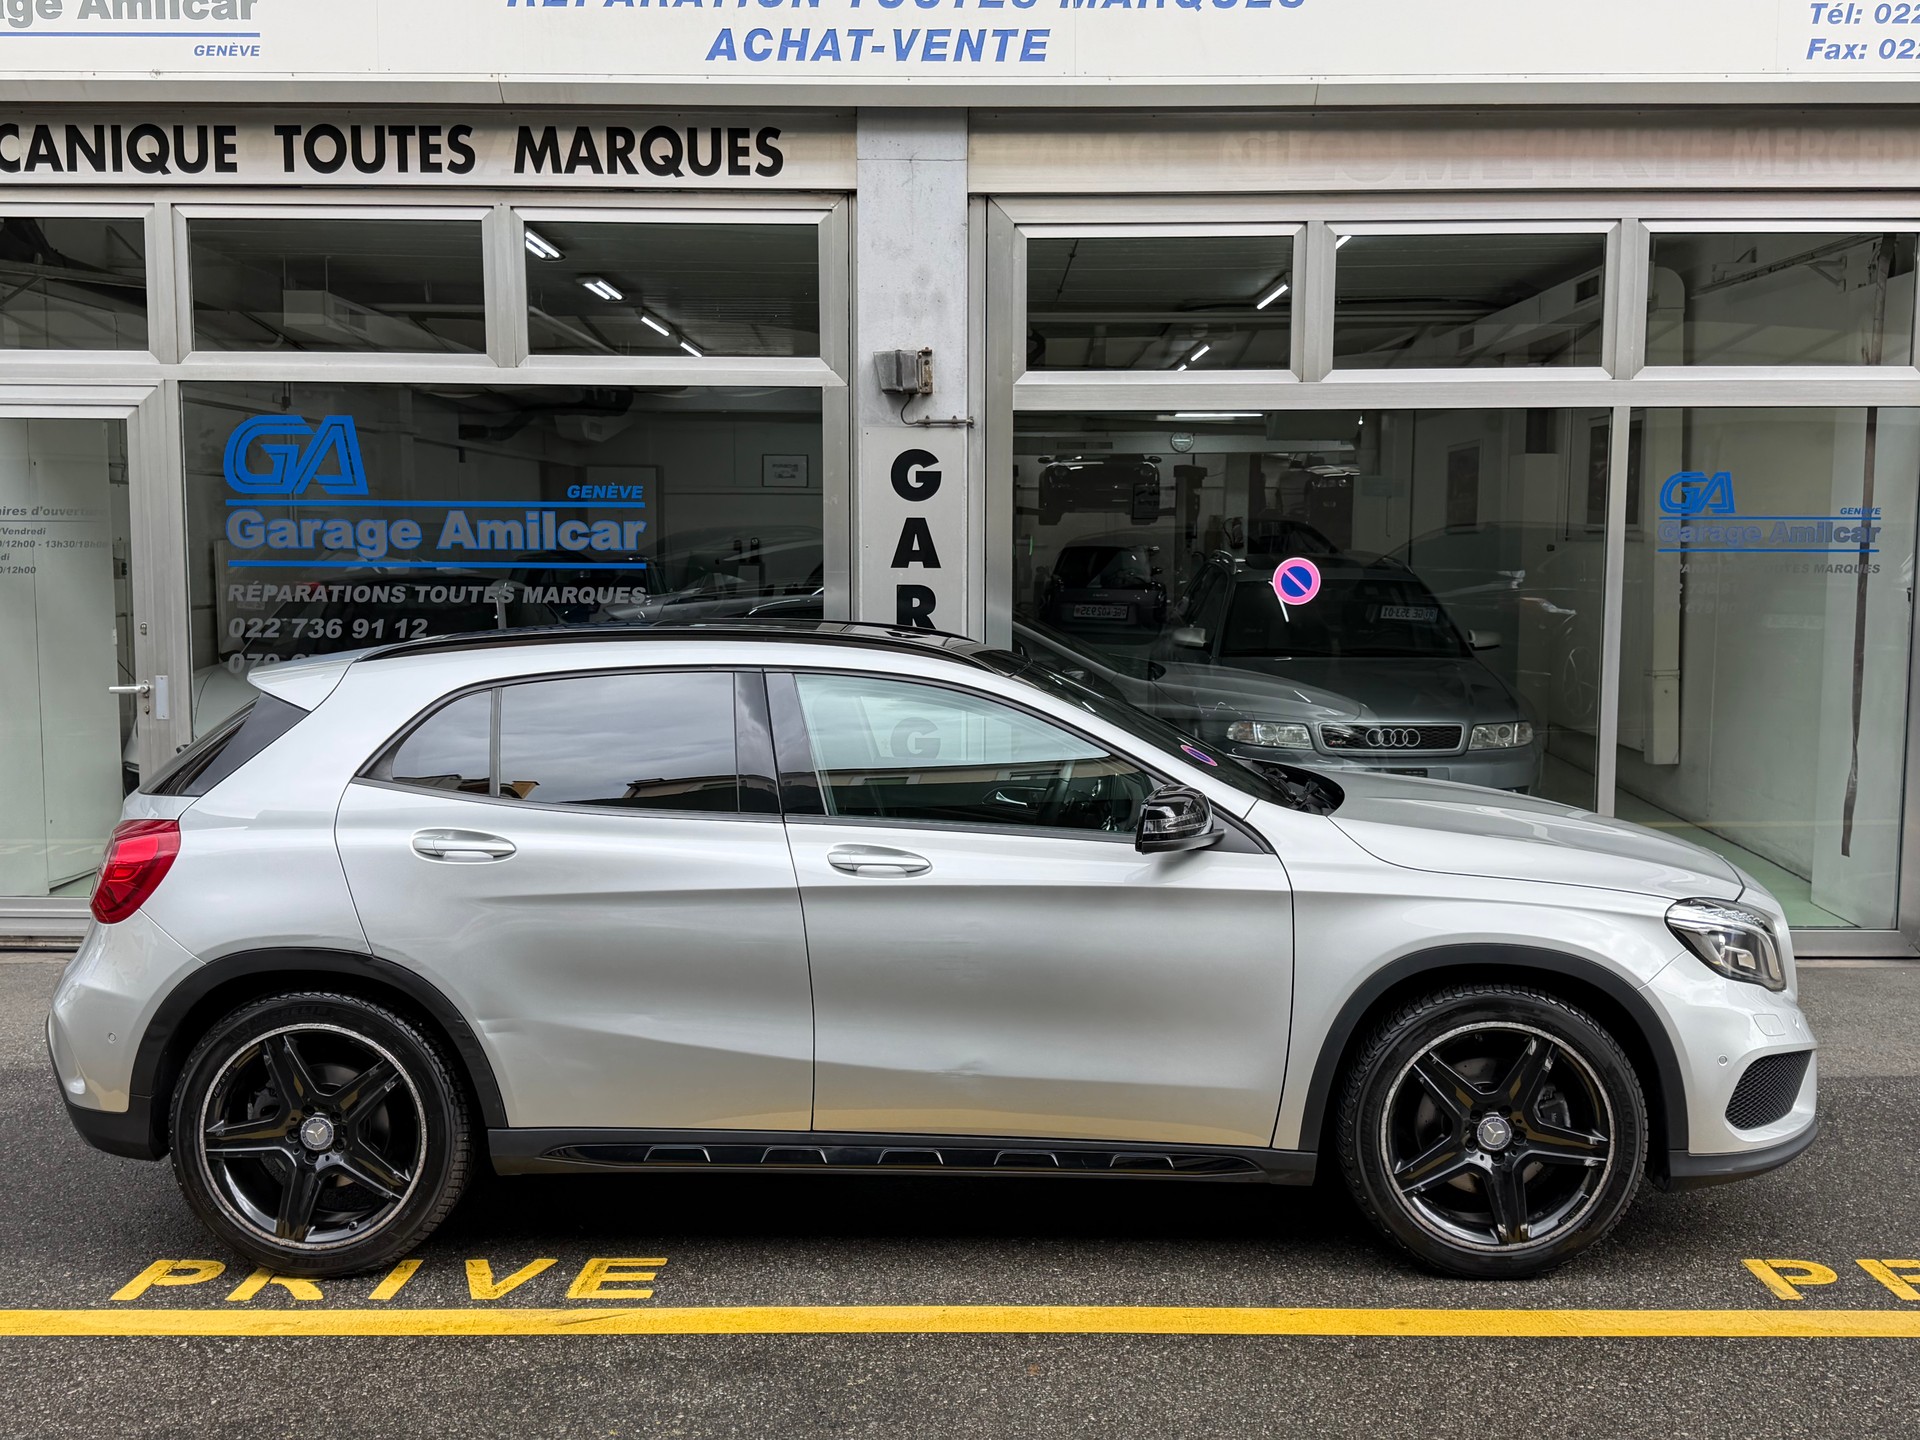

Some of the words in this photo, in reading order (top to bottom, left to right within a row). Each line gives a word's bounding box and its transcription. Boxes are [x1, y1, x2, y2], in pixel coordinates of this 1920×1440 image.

[0, 0, 63, 28] ge
[1810, 3, 1863, 25] Tél:
[193, 42, 261, 57] GENÈVE
[705, 28, 1051, 62] ACHAT-VENTE
[1806, 38, 1868, 60] Fax:
[1878, 38, 1920, 60] 02
[0, 124, 238, 175] CANIQUE
[273, 124, 475, 175] TOUTES
[513, 125, 784, 178] MARQUES
[222, 414, 369, 495] GA
[566, 482, 644, 499] GENÈVE
[1659, 471, 1736, 514] GA
[0, 506, 27, 516] ires
[225, 508, 422, 560] Garage
[436, 510, 647, 551] Amilcar
[1657, 521, 1762, 547] Garage
[1768, 521, 1881, 544] Amilcar
[228, 581, 405, 604] RÉPARATIONS
[415, 586, 514, 604] TOUTES
[523, 586, 646, 605] MARQUES
[228, 617, 281, 638] 022
[292, 618, 342, 638] 736
[352, 618, 388, 639] 91
[394, 619, 428, 639] 12
[109, 1257, 668, 1301] PRIVE
